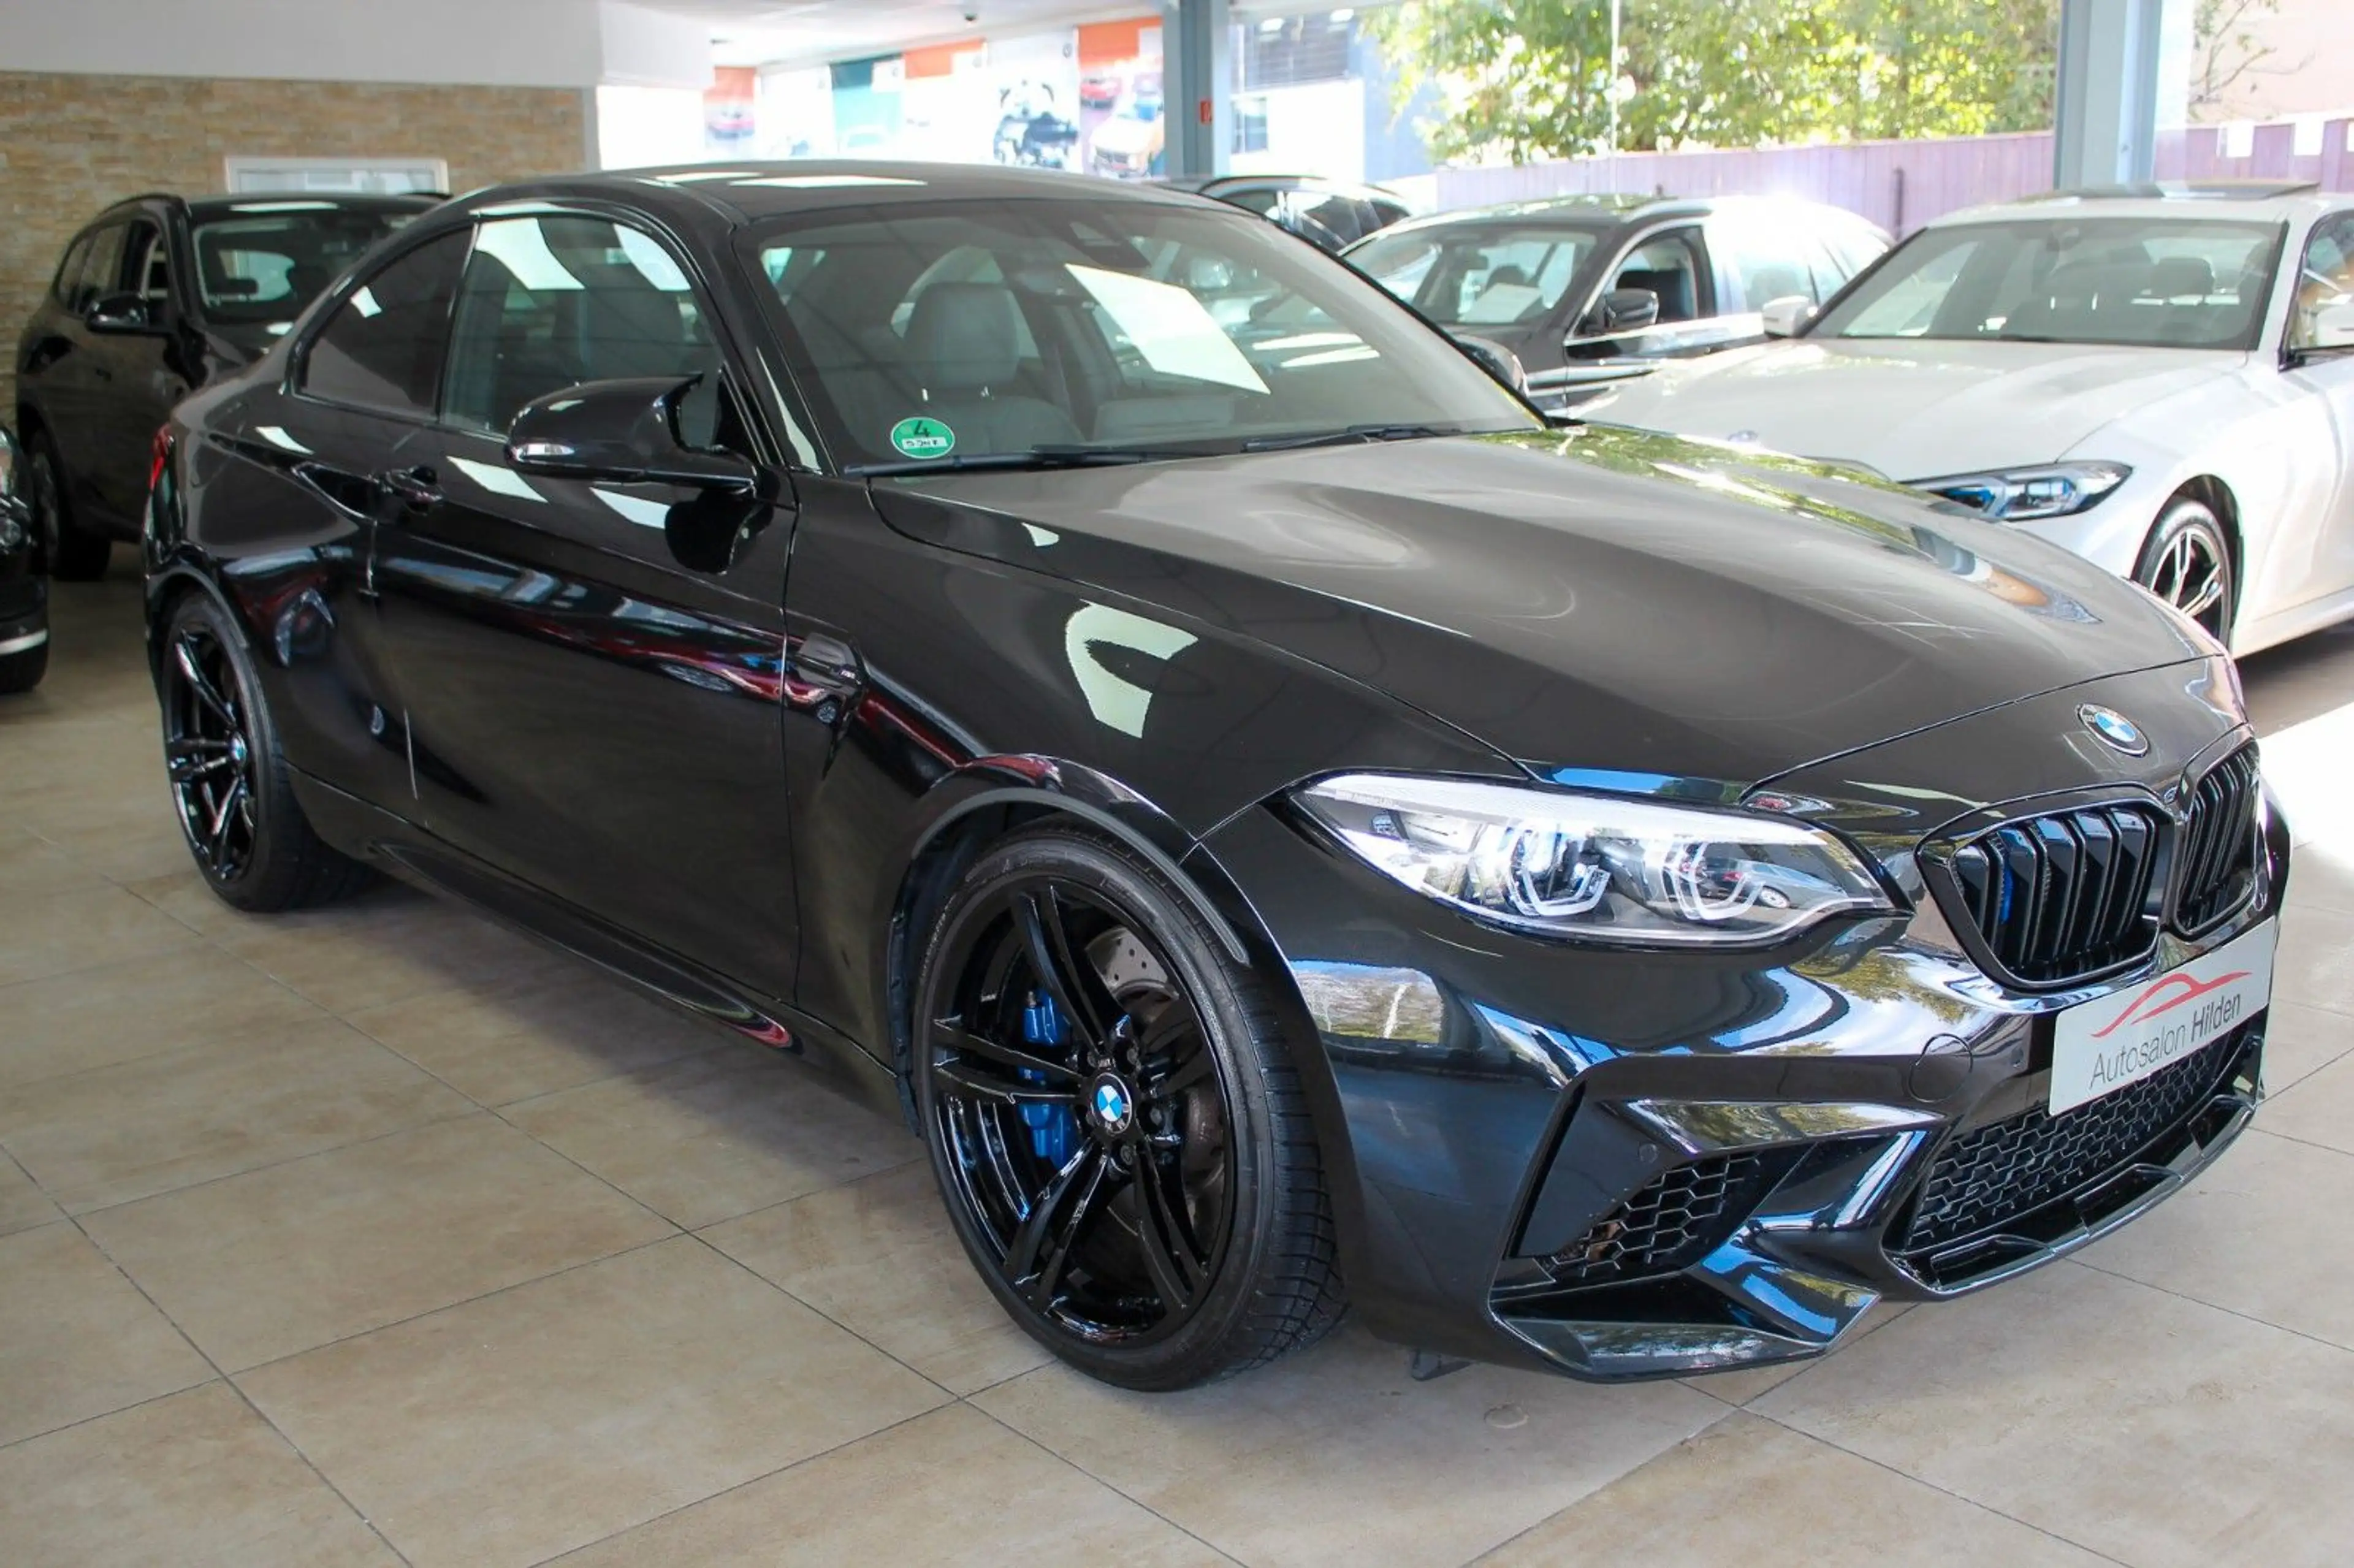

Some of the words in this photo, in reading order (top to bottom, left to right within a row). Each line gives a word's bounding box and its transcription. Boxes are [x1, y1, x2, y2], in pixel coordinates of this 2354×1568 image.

[914, 421, 931, 437] 4
[2090, 1024, 2185, 1088] Autosalon
[2191, 993, 2241, 1042] Hilden
